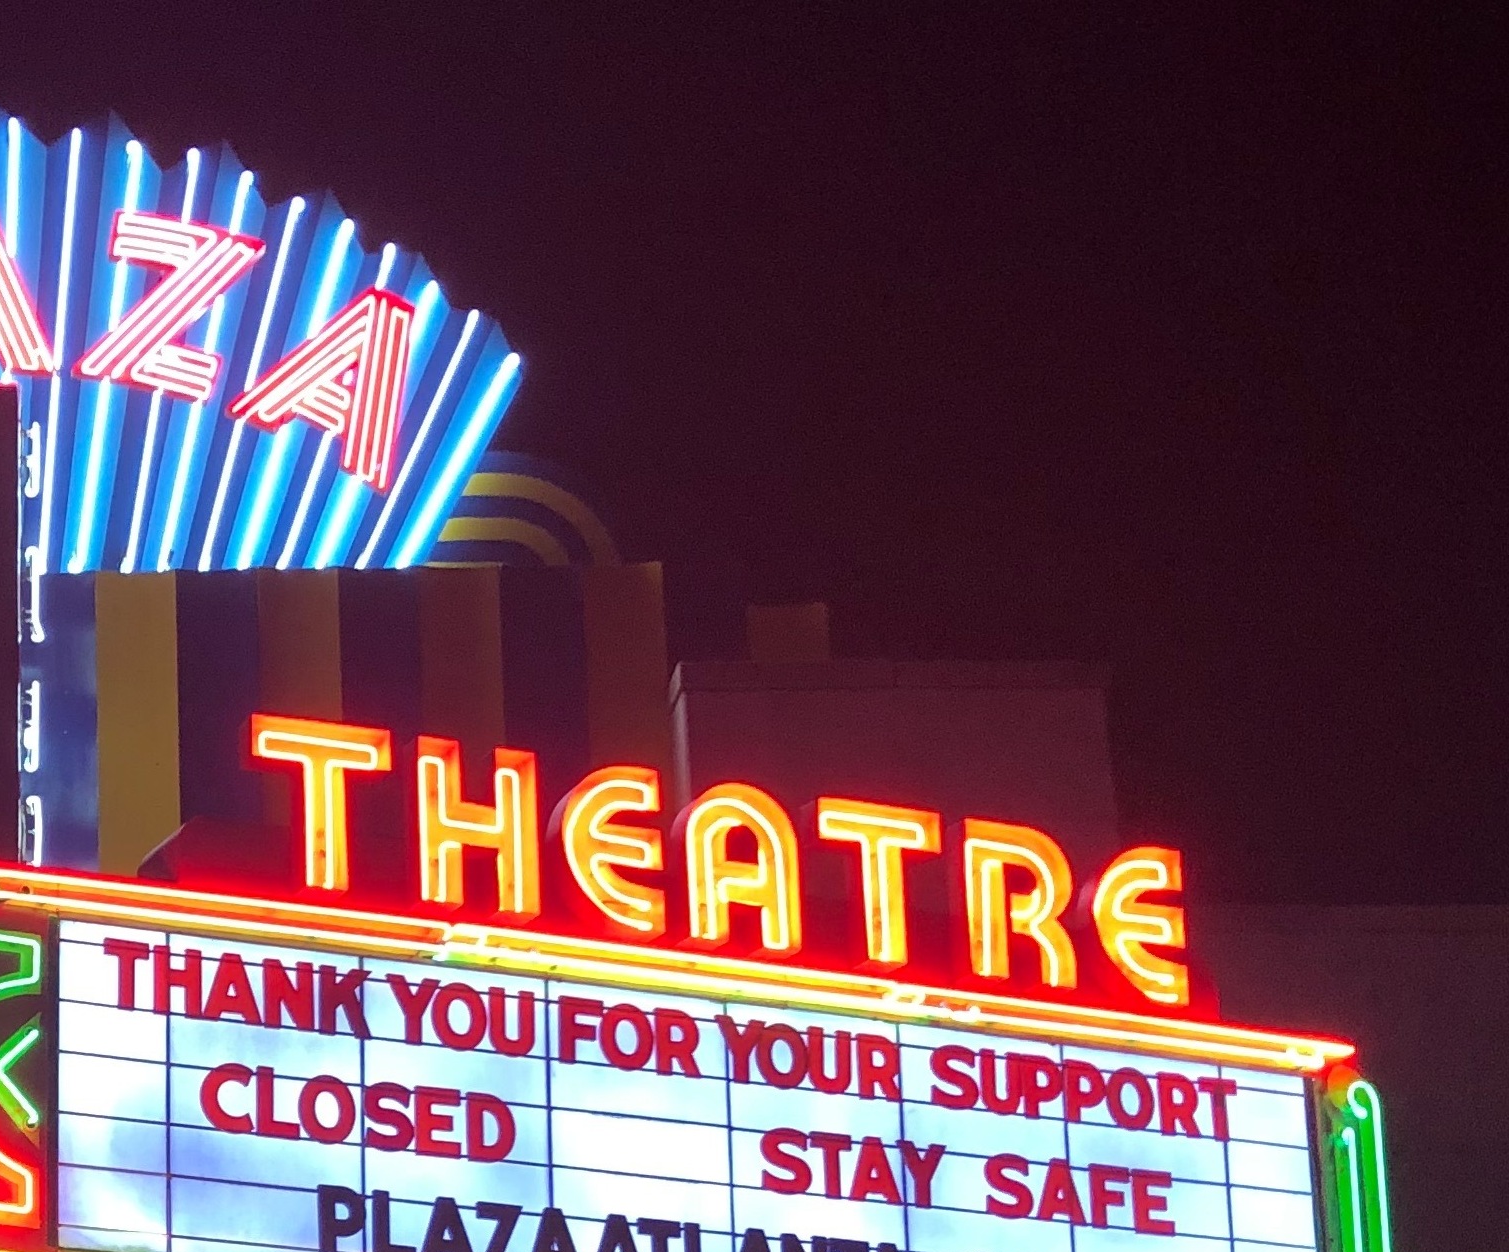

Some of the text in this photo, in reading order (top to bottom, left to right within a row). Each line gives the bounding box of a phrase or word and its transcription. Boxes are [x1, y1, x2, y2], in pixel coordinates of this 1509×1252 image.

[250, 713, 1190, 1006] THEATRE
[103, 937, 1237, 1141] THANK YOU FOR YOUR SUPPORT
[199, 1062, 1176, 1236] CLOSED STAY SAFE
